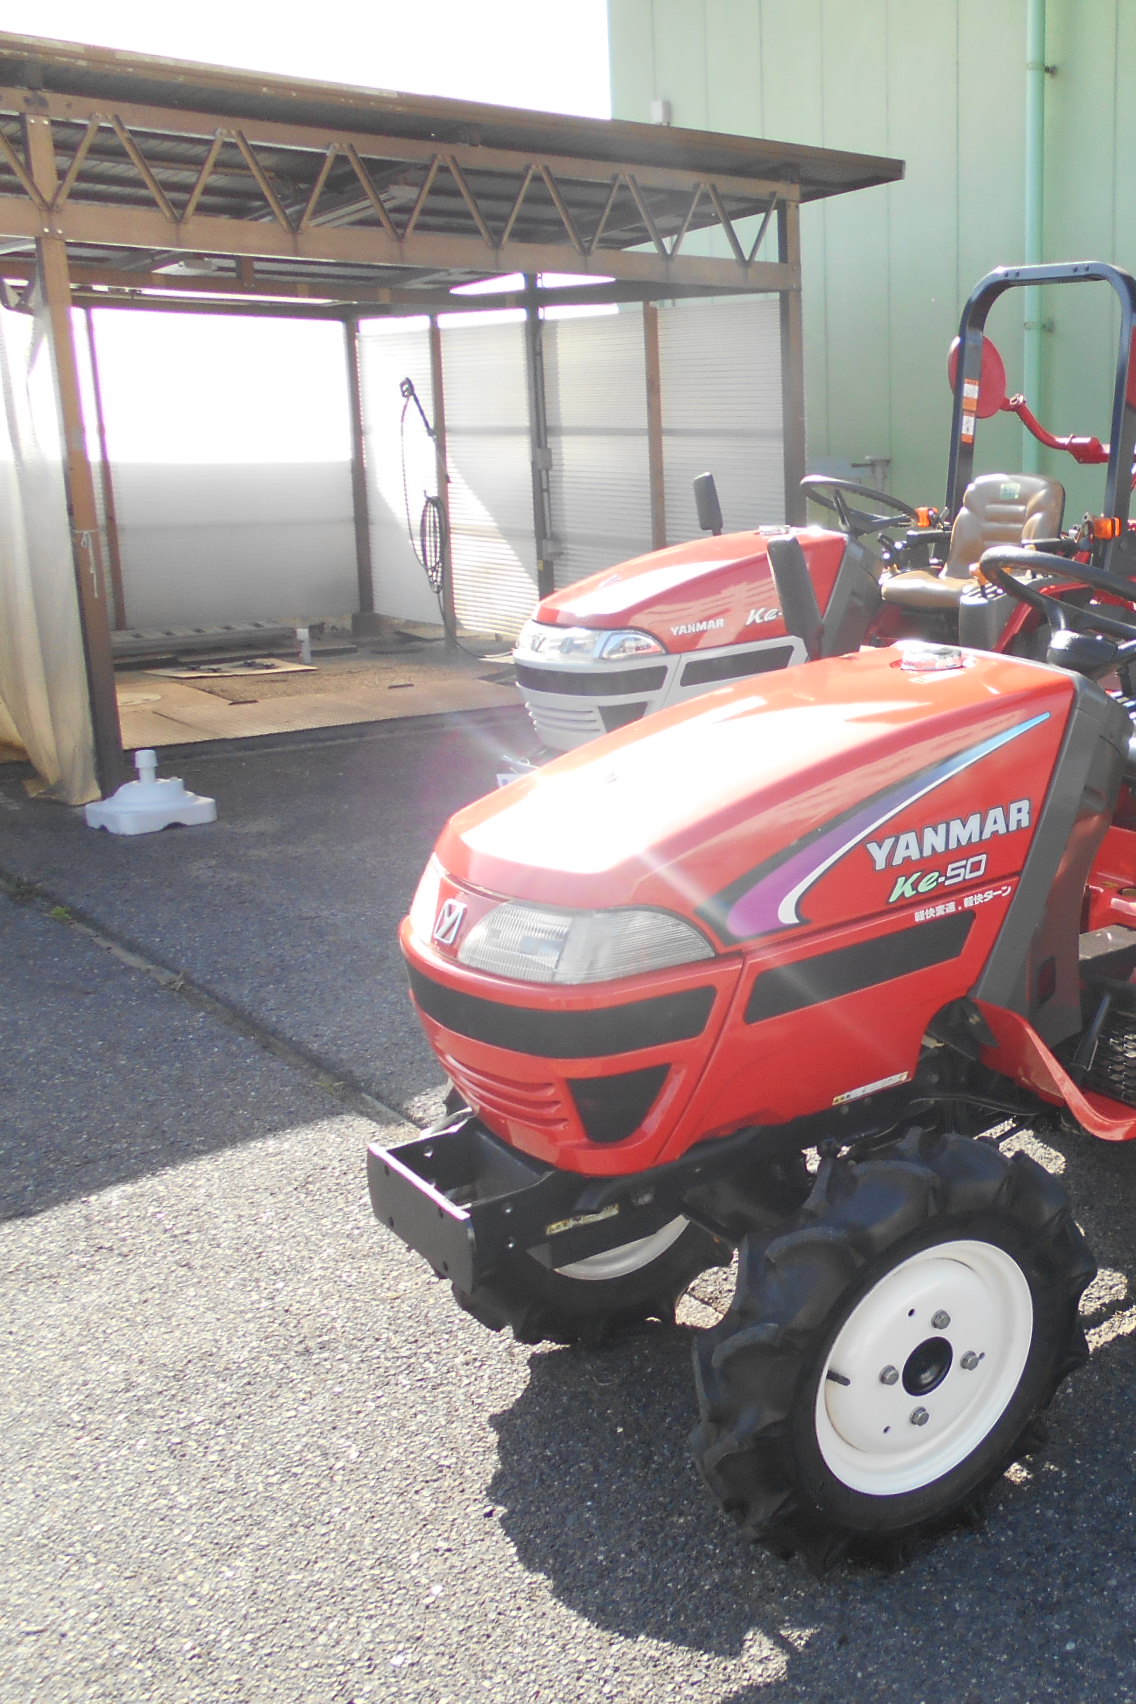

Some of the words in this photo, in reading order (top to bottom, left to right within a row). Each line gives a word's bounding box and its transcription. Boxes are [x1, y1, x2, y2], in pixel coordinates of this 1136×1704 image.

[670, 618, 725, 636] YANMAR
[866, 799, 1031, 871] YANMAR
[888, 854, 987, 902] Ke-50
